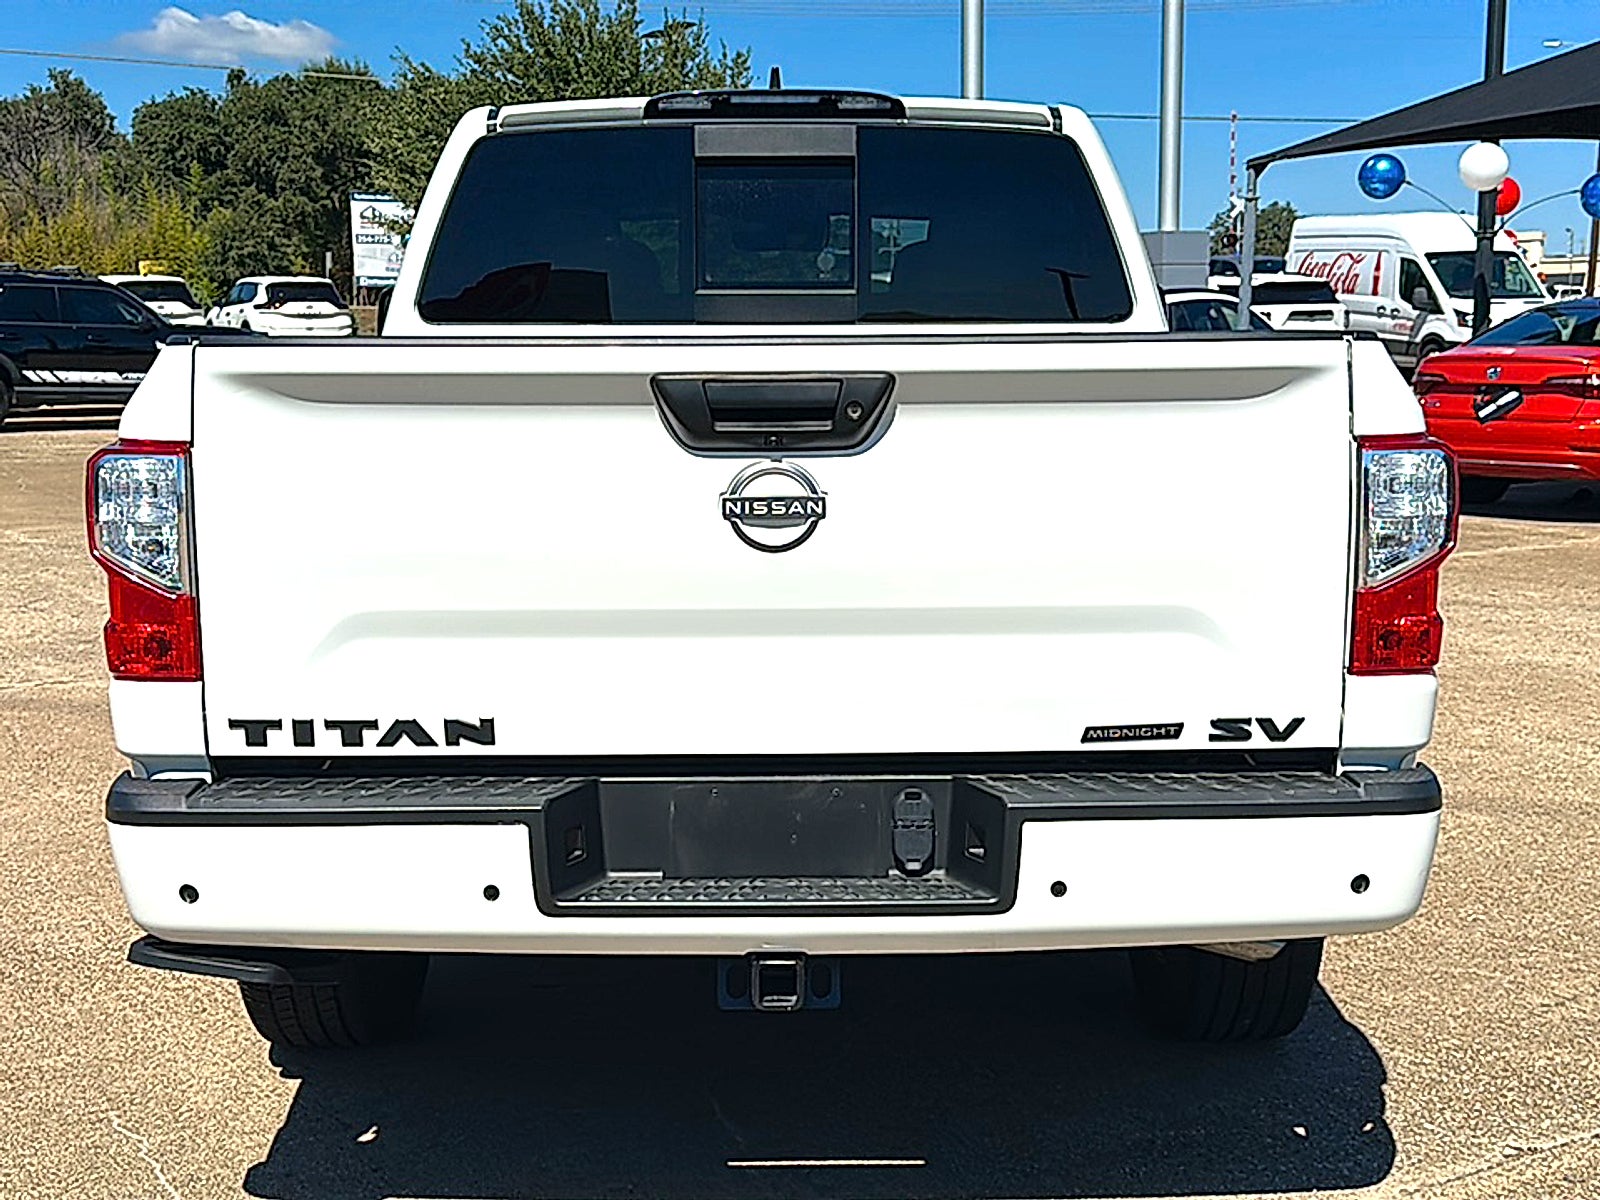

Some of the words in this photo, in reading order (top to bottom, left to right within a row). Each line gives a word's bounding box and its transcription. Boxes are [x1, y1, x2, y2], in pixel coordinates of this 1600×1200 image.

[725, 500, 823, 515] NISSAN
[228, 718, 496, 747] TITAN
[1085, 725, 1181, 741] MIDNIGHT
[1208, 717, 1306, 742] SV
